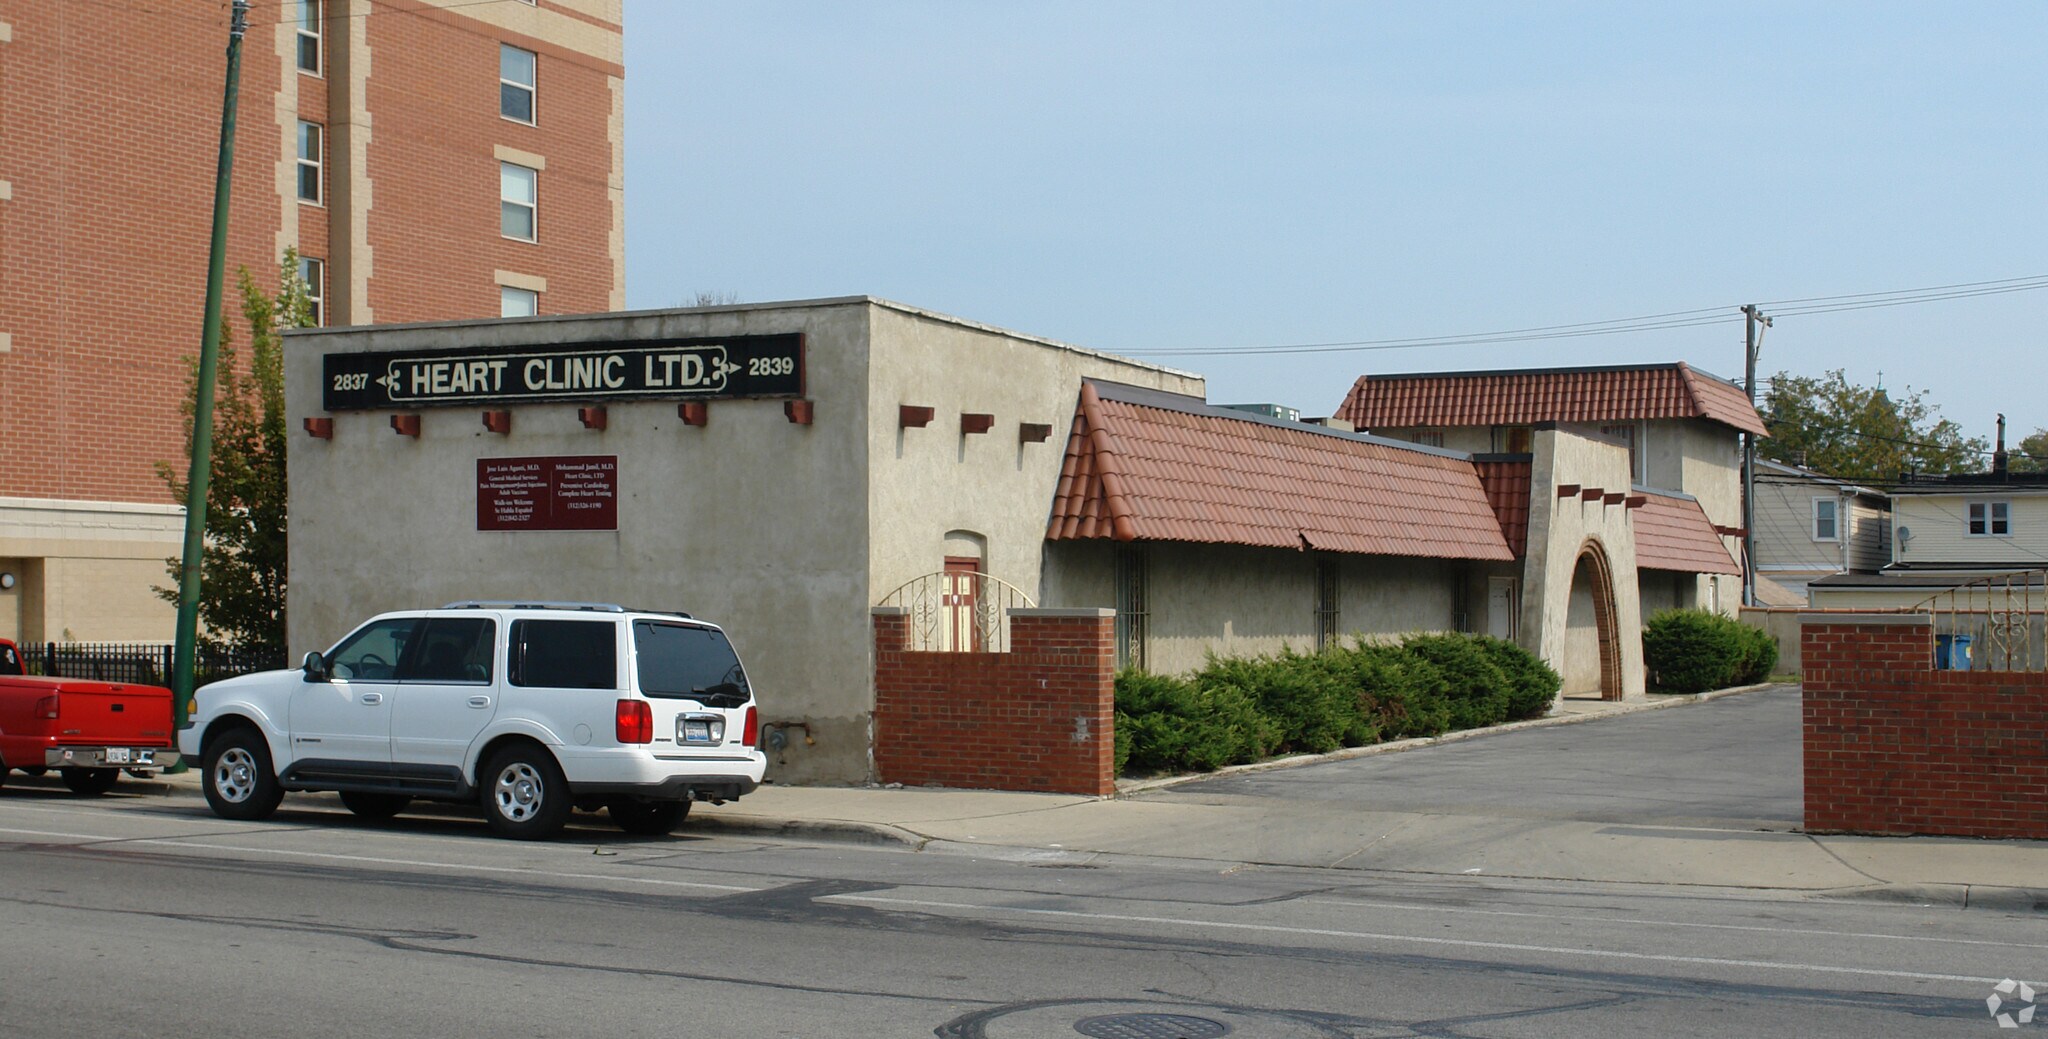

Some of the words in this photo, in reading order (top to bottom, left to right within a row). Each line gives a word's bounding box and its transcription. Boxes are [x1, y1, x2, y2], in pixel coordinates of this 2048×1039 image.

[333, 373, 370, 392] 2837
[411, 361, 508, 396] HEART
[523, 354, 628, 391] CLINIC
[645, 354, 713, 388] LTD.
[749, 357, 795, 376] 2839
[557, 490, 580, 498] Complete
